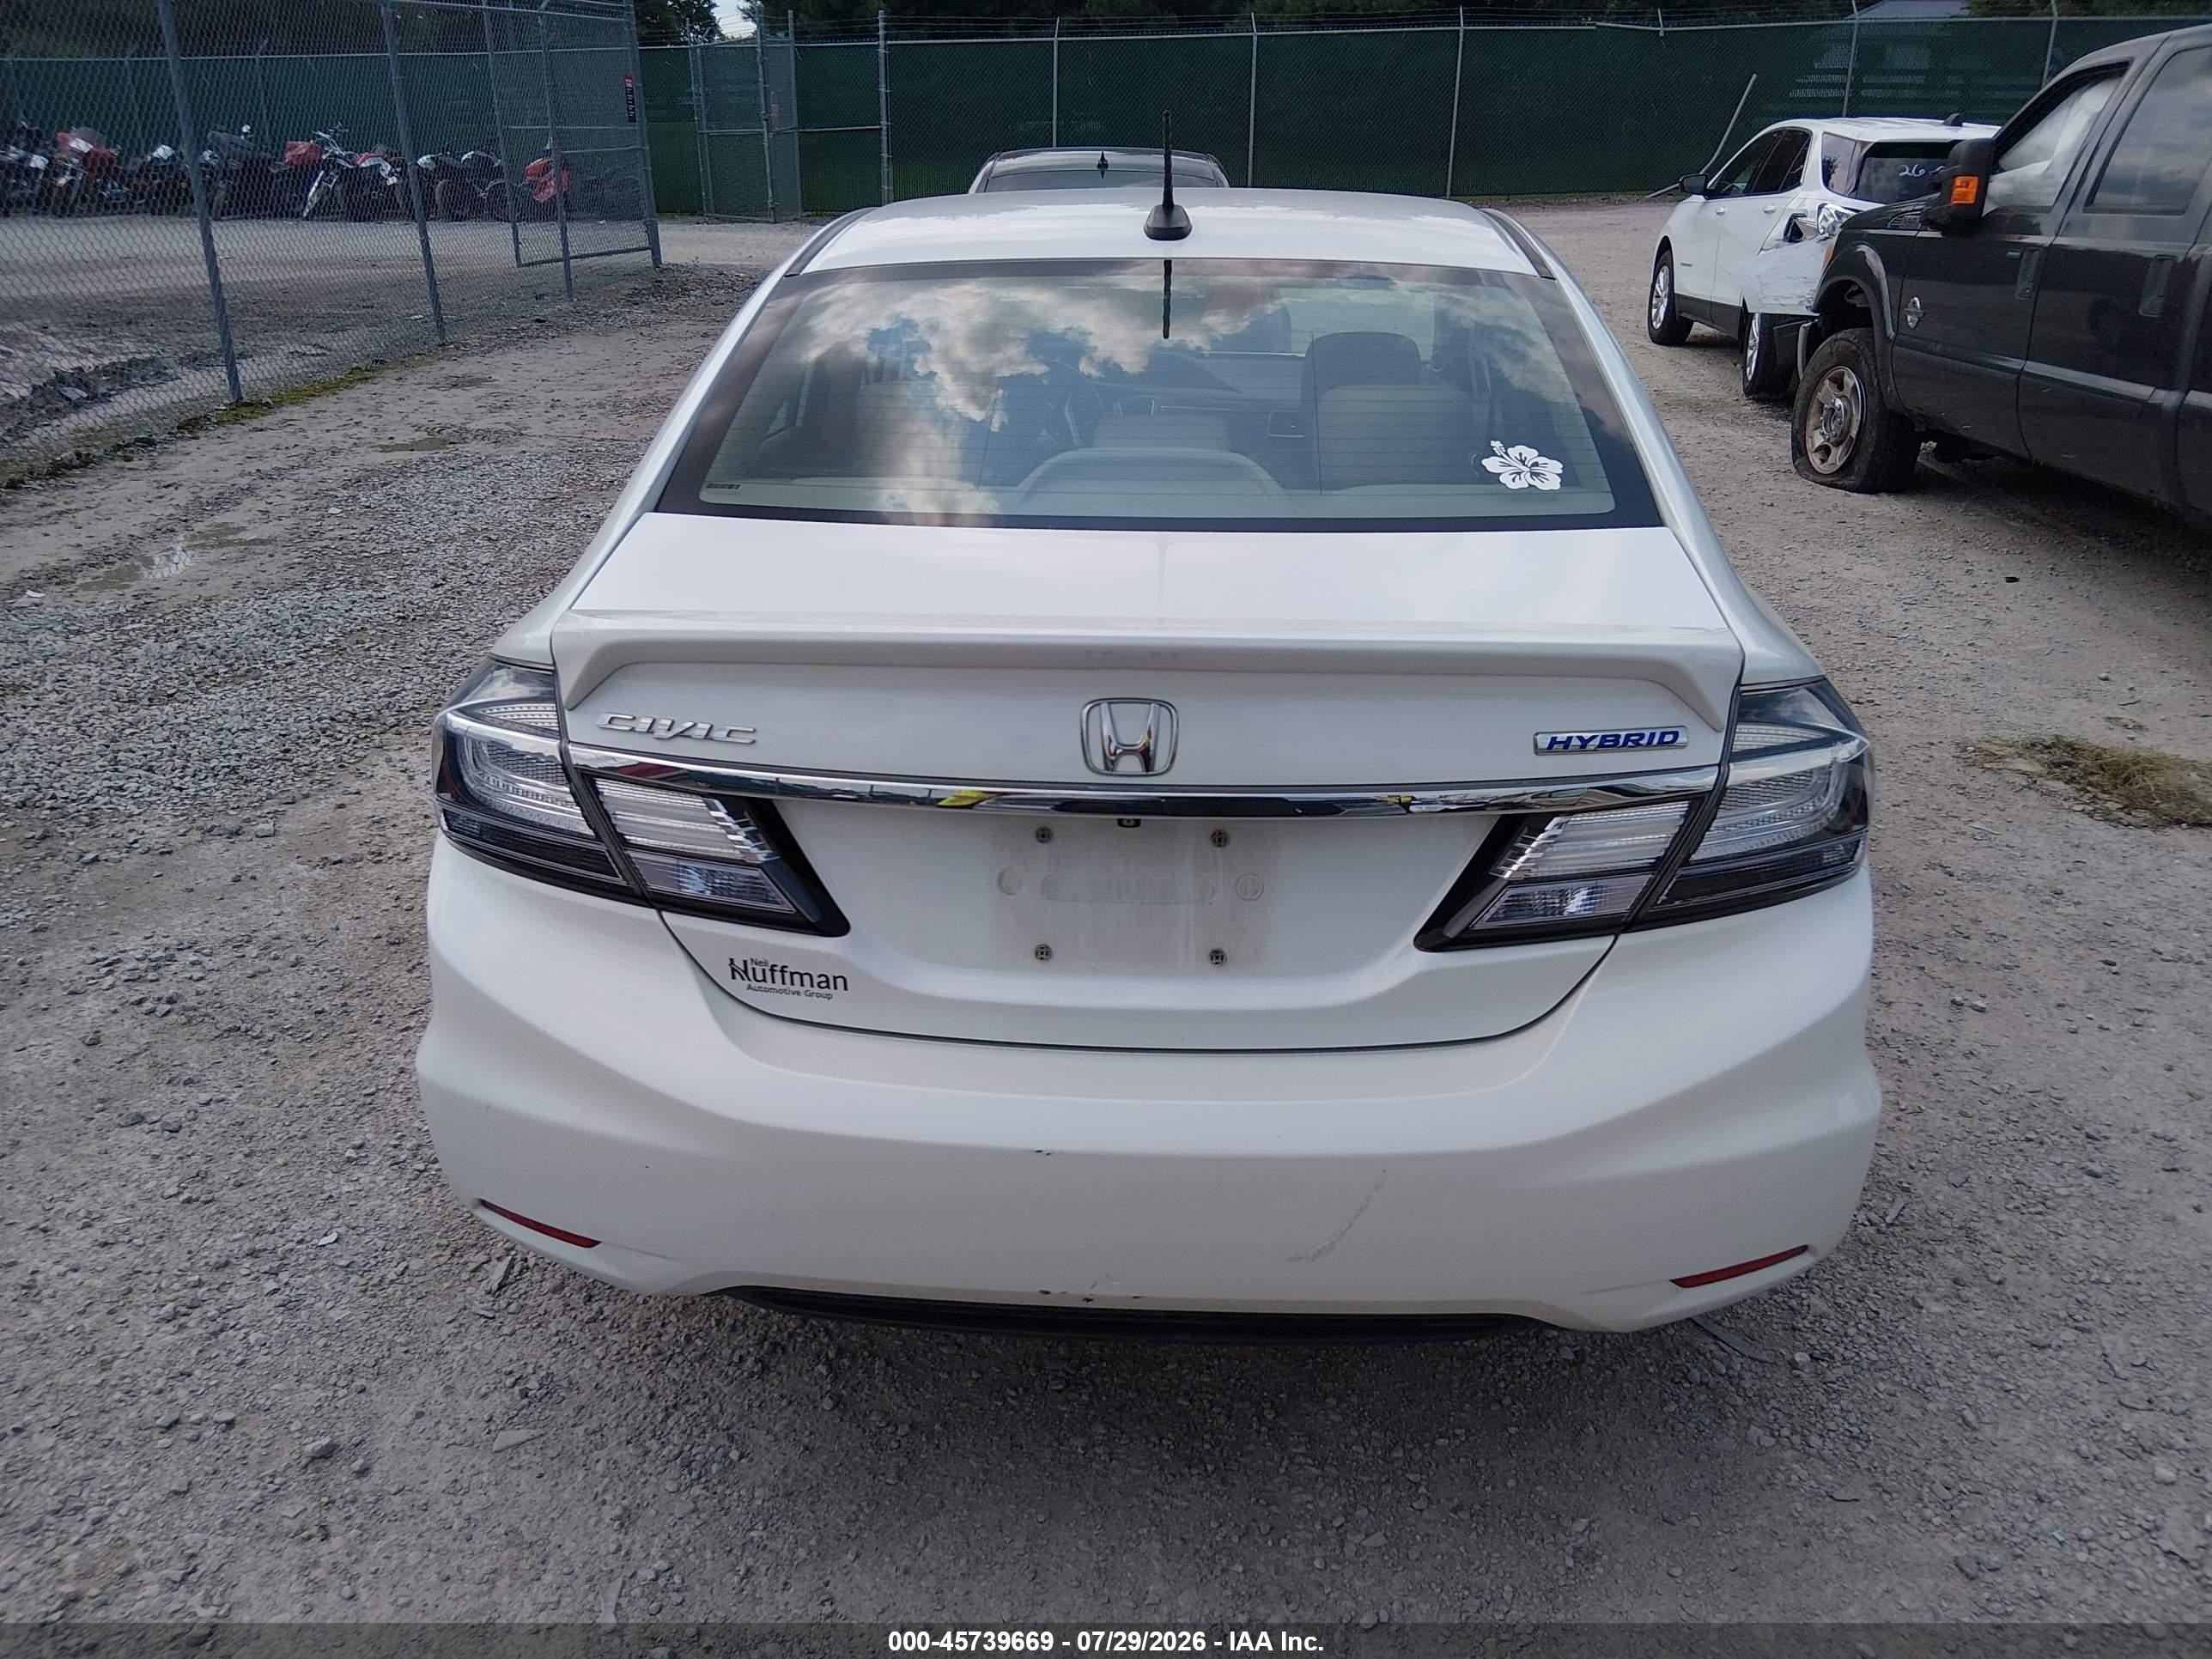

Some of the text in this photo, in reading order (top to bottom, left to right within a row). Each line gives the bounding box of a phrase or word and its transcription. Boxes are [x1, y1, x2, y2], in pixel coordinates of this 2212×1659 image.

[1899, 164, 1925, 177] 26
[597, 712, 757, 744] CIVIC
[1547, 730, 1680, 750] HYBRID
[750, 957, 769, 967] Neil
[746, 983, 834, 1000] Automotive Group
